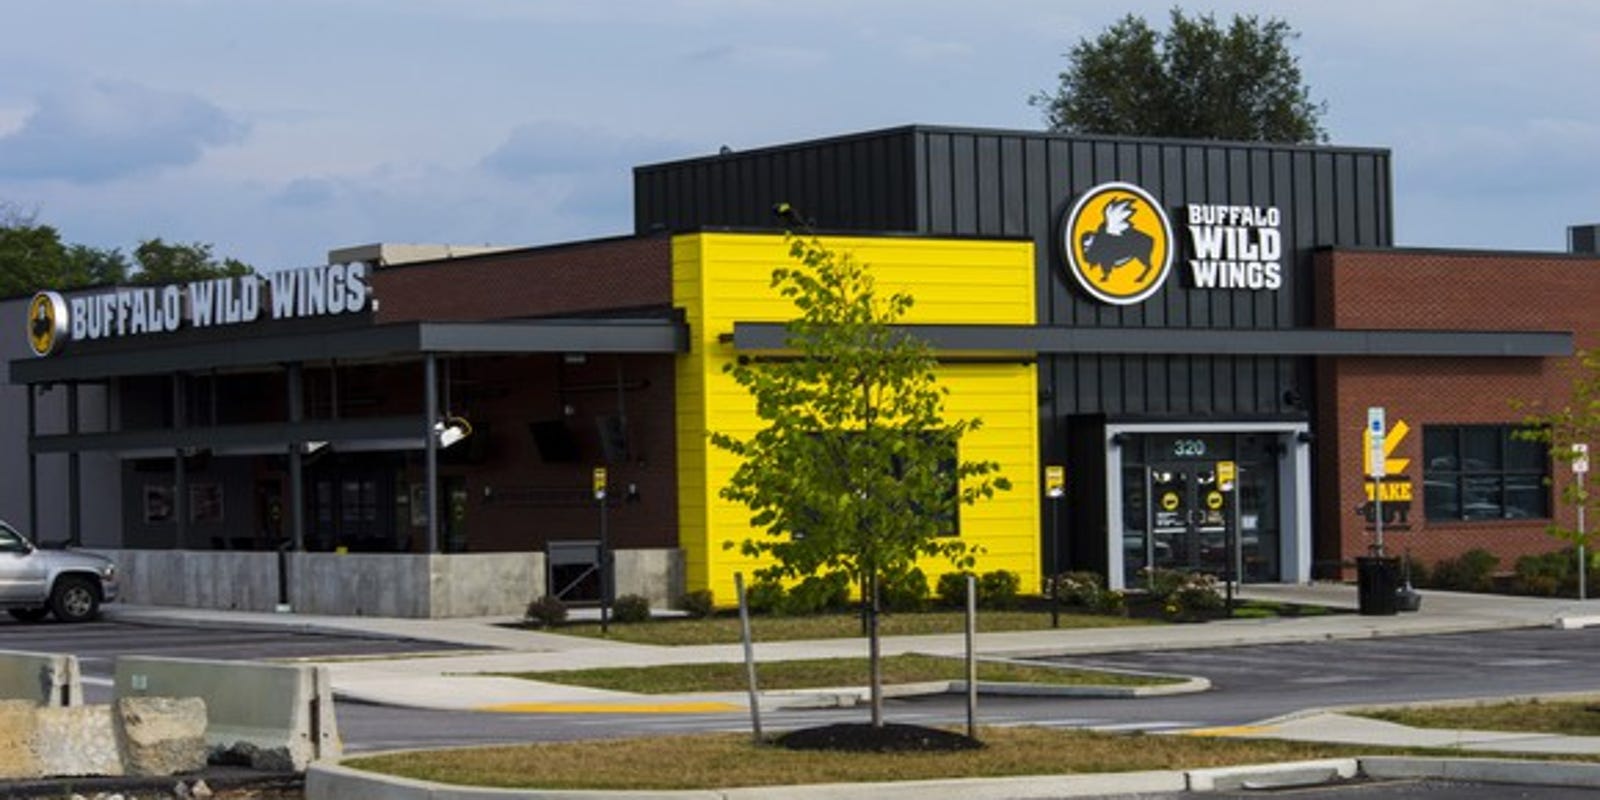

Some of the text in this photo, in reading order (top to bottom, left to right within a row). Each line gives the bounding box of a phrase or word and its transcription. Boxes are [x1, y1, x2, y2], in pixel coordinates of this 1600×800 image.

[1187, 203, 1281, 227] BUFFALO
[1188, 226, 1282, 261] WILD
[1189, 260, 1282, 290] WINGS
[71, 261, 367, 341] BUFFALO WILD WINGS
[1173, 439, 1206, 456] 320
[1364, 481, 1412, 501] TAKE
